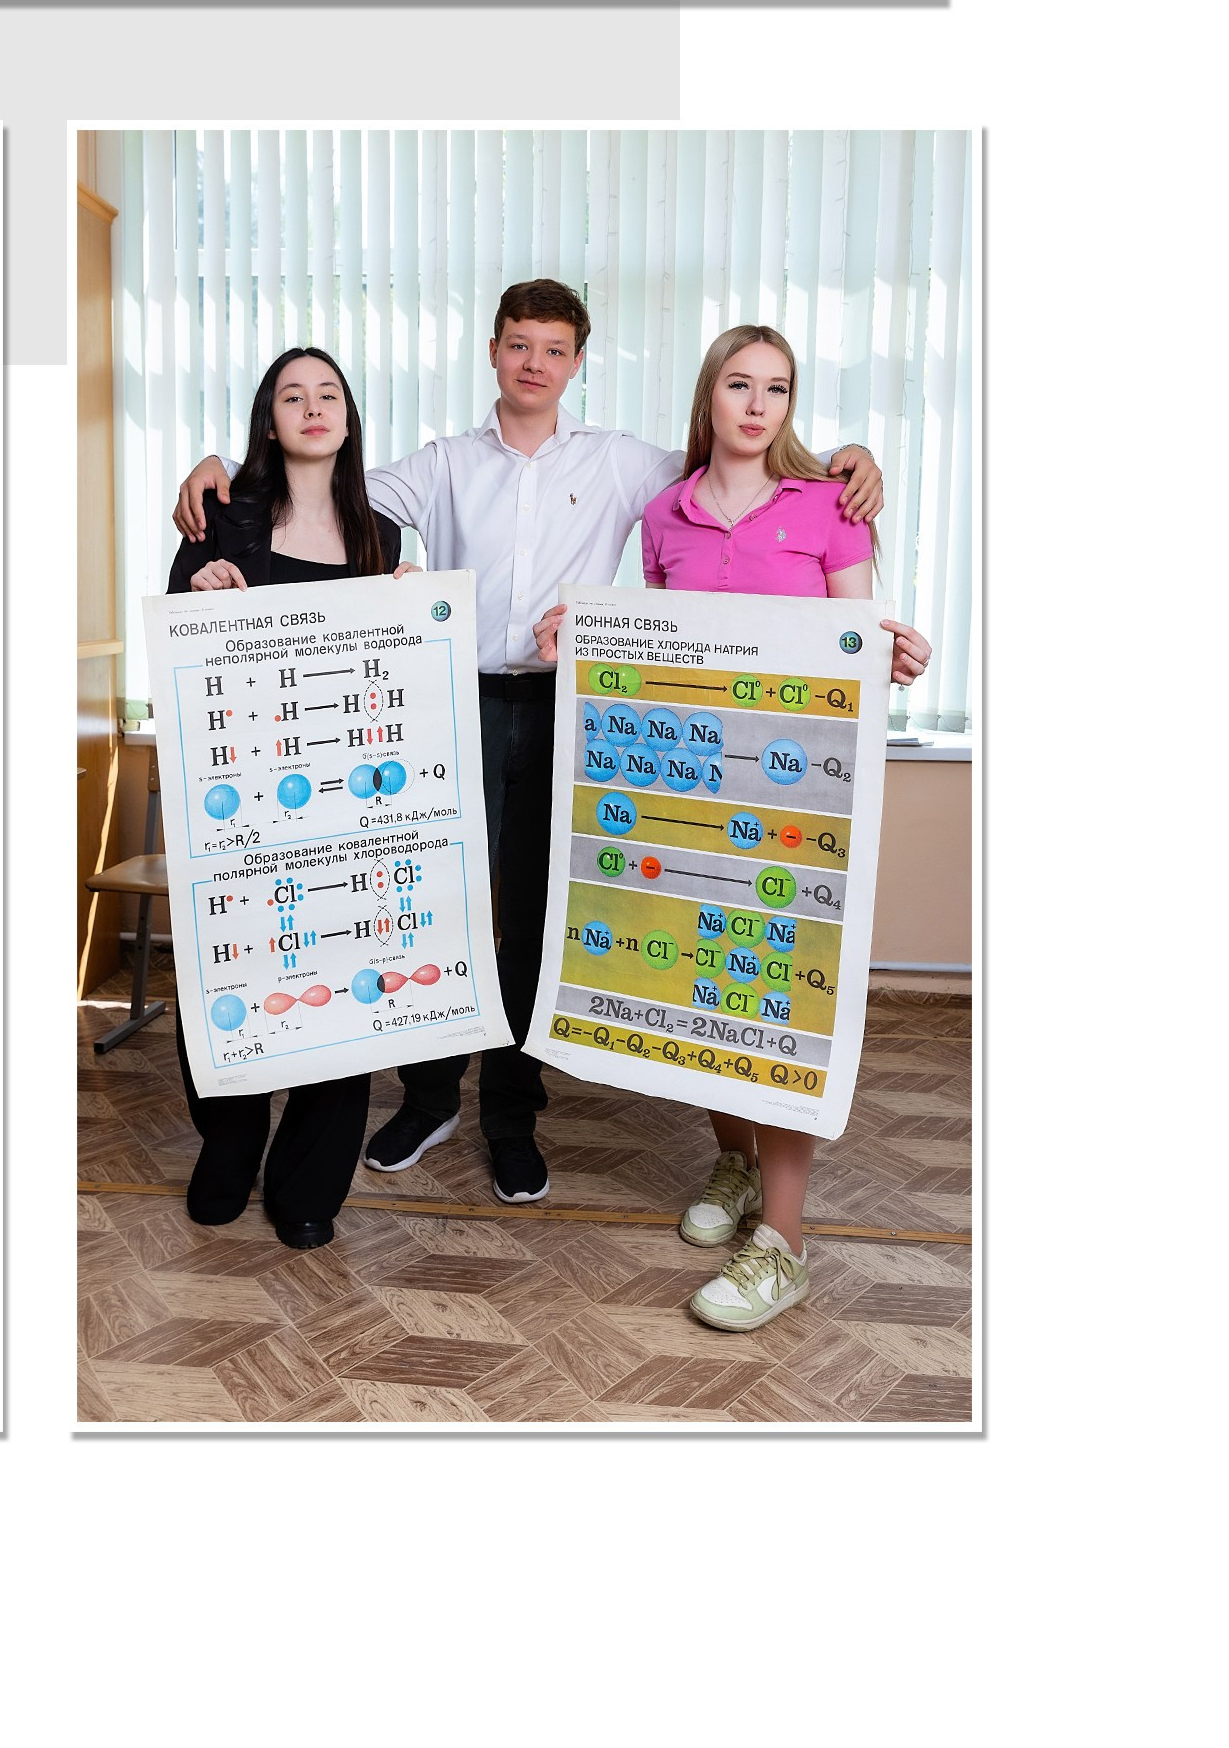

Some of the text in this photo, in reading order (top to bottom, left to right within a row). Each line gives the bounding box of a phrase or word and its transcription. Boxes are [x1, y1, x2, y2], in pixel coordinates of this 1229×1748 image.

[433, 605, 447, 617] 12
[169, 611, 326, 638] КОВАЛЕНТНАЯ СВЯЗЬ
[575, 614, 678, 632] ИОННАЯ СВЯЗЬ
[225, 624, 405, 653] Образование ковалентной
[575, 634, 759, 656] ОБРАЗОВАНИЕ ХЛОРИДА НАТРИЯ
[841, 637, 857, 648] 13
[205, 635, 423, 667] неполярной молекулы водорода
[575, 647, 704, 664] ИЗ ПРОСТЫХ ВЕЩЕСТВ
[204, 676, 224, 696] H
[278, 668, 297, 688] H
[607, 715, 637, 736] Na
[647, 720, 677, 741] Na
[688, 724, 721, 744] Na
[585, 750, 616, 770] Na
[626, 754, 656, 774] Na
[667, 759, 698, 780] Na
[768, 751, 802, 772] Na
[375, 796, 382, 805] R
[405, 807, 457, 822] кДж/моль
[602, 803, 632, 824] Na
[243, 830, 419, 866] Образование ковалентной
[213, 838, 449, 882] полярной молекулы хлороводорода
[566, 926, 580, 941] n
[388, 999, 396, 1008] R
[423, 1006, 476, 1021] кДж/моль
